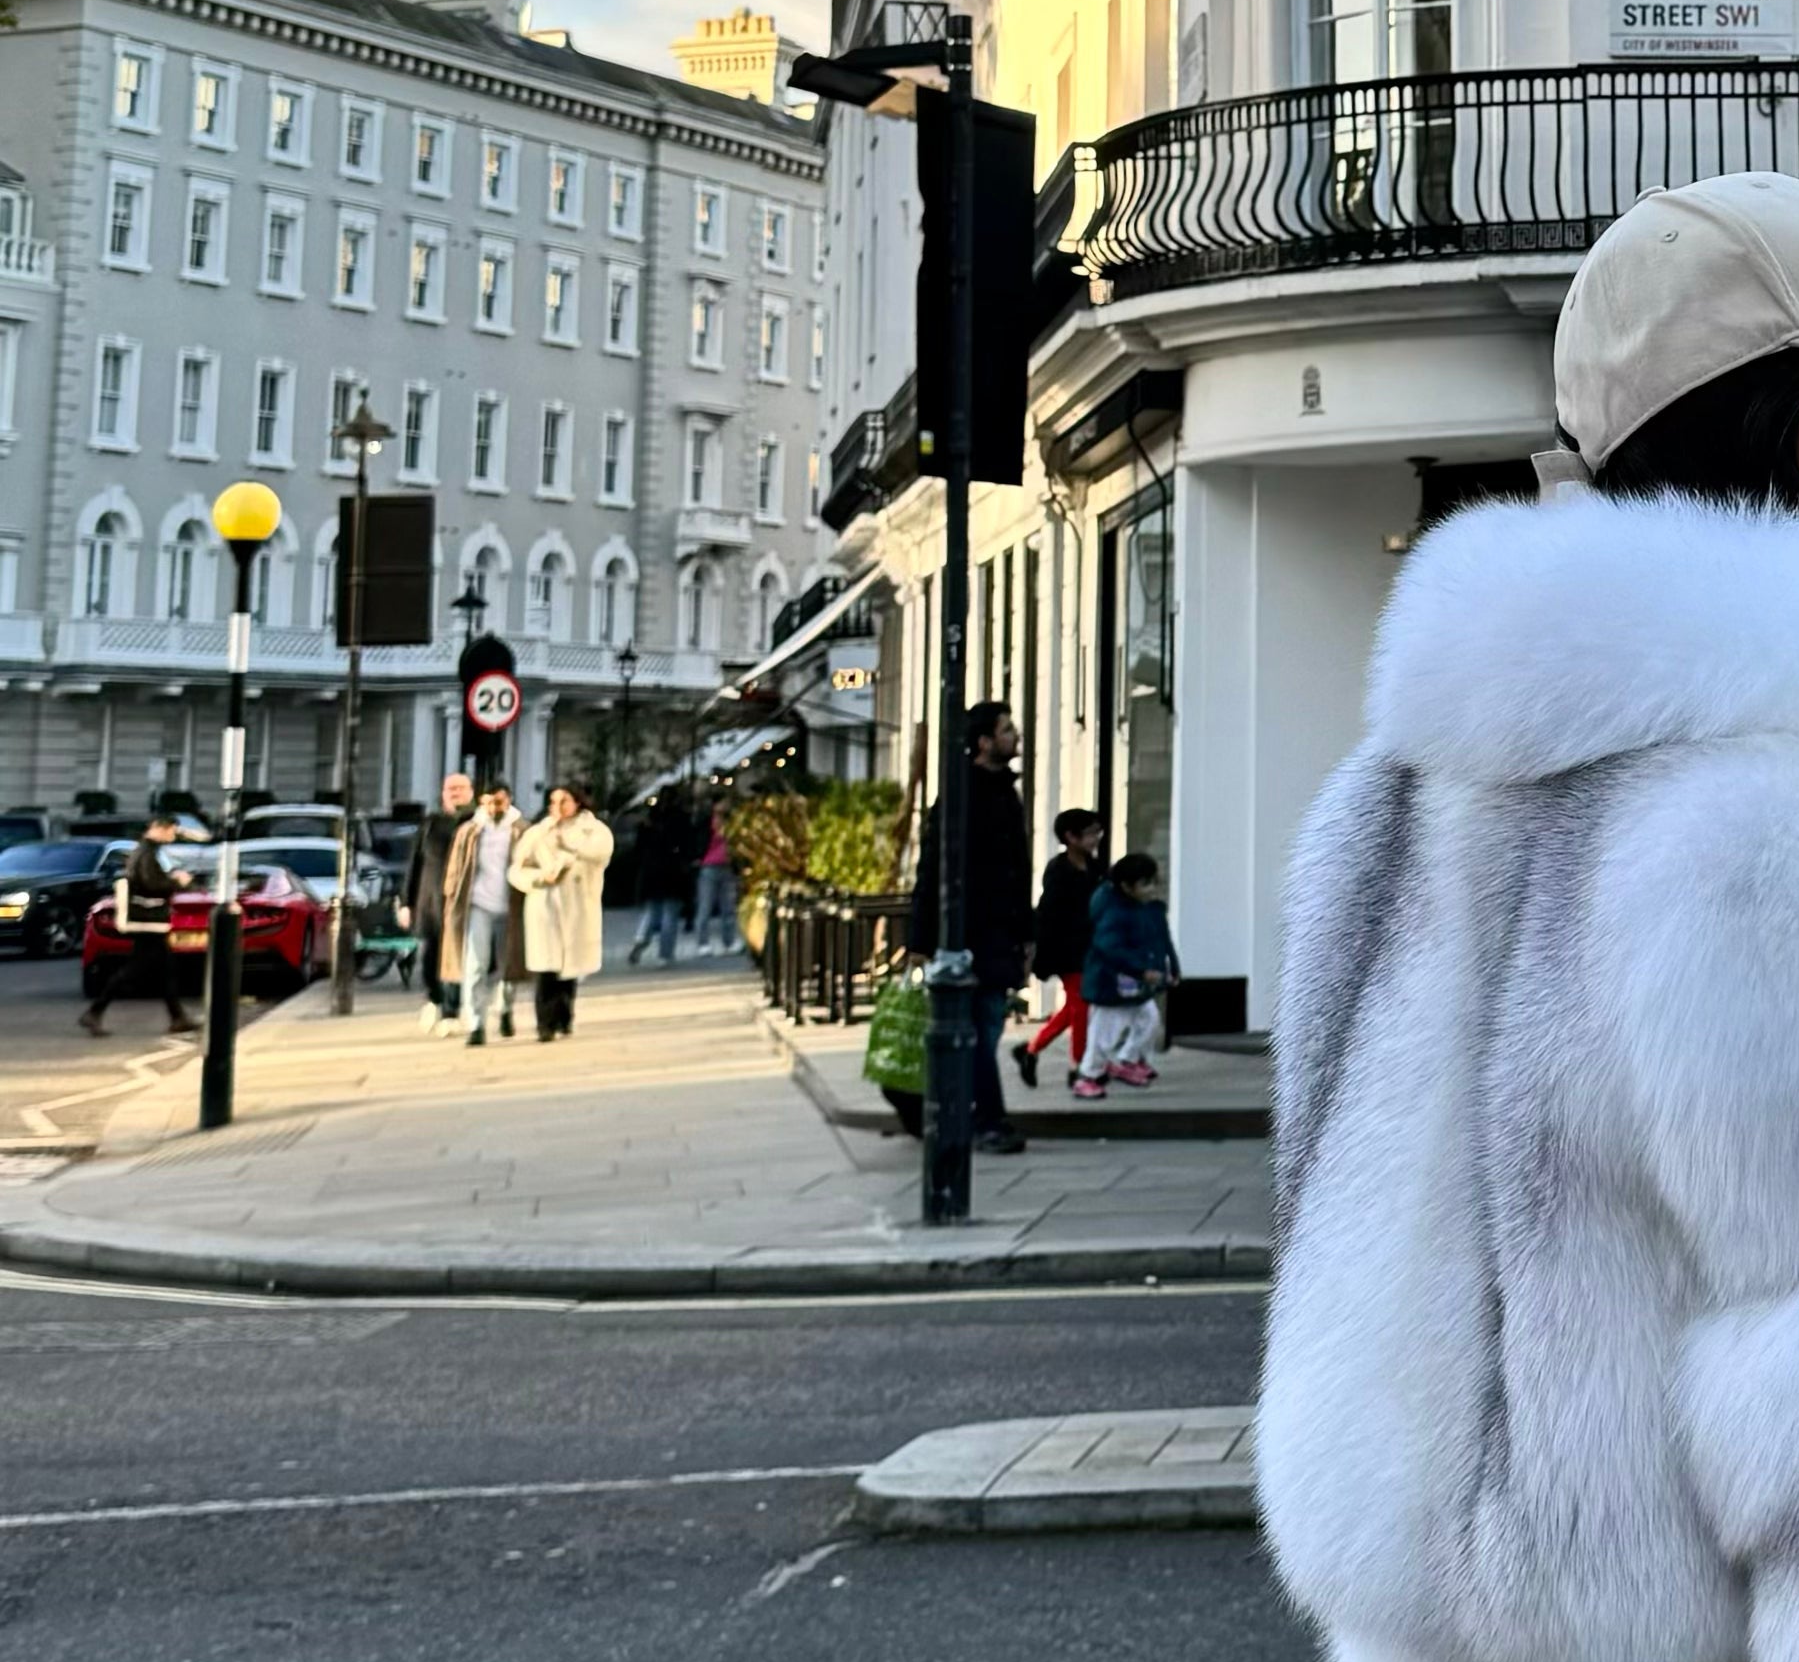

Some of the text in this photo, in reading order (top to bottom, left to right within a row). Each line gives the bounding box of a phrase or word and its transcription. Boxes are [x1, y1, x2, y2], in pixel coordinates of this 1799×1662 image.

[1623, 4, 1759, 27] STREET SW1
[1623, 39, 1739, 50] CITY OF WESTMINSTER
[479, 688, 515, 713] 20
